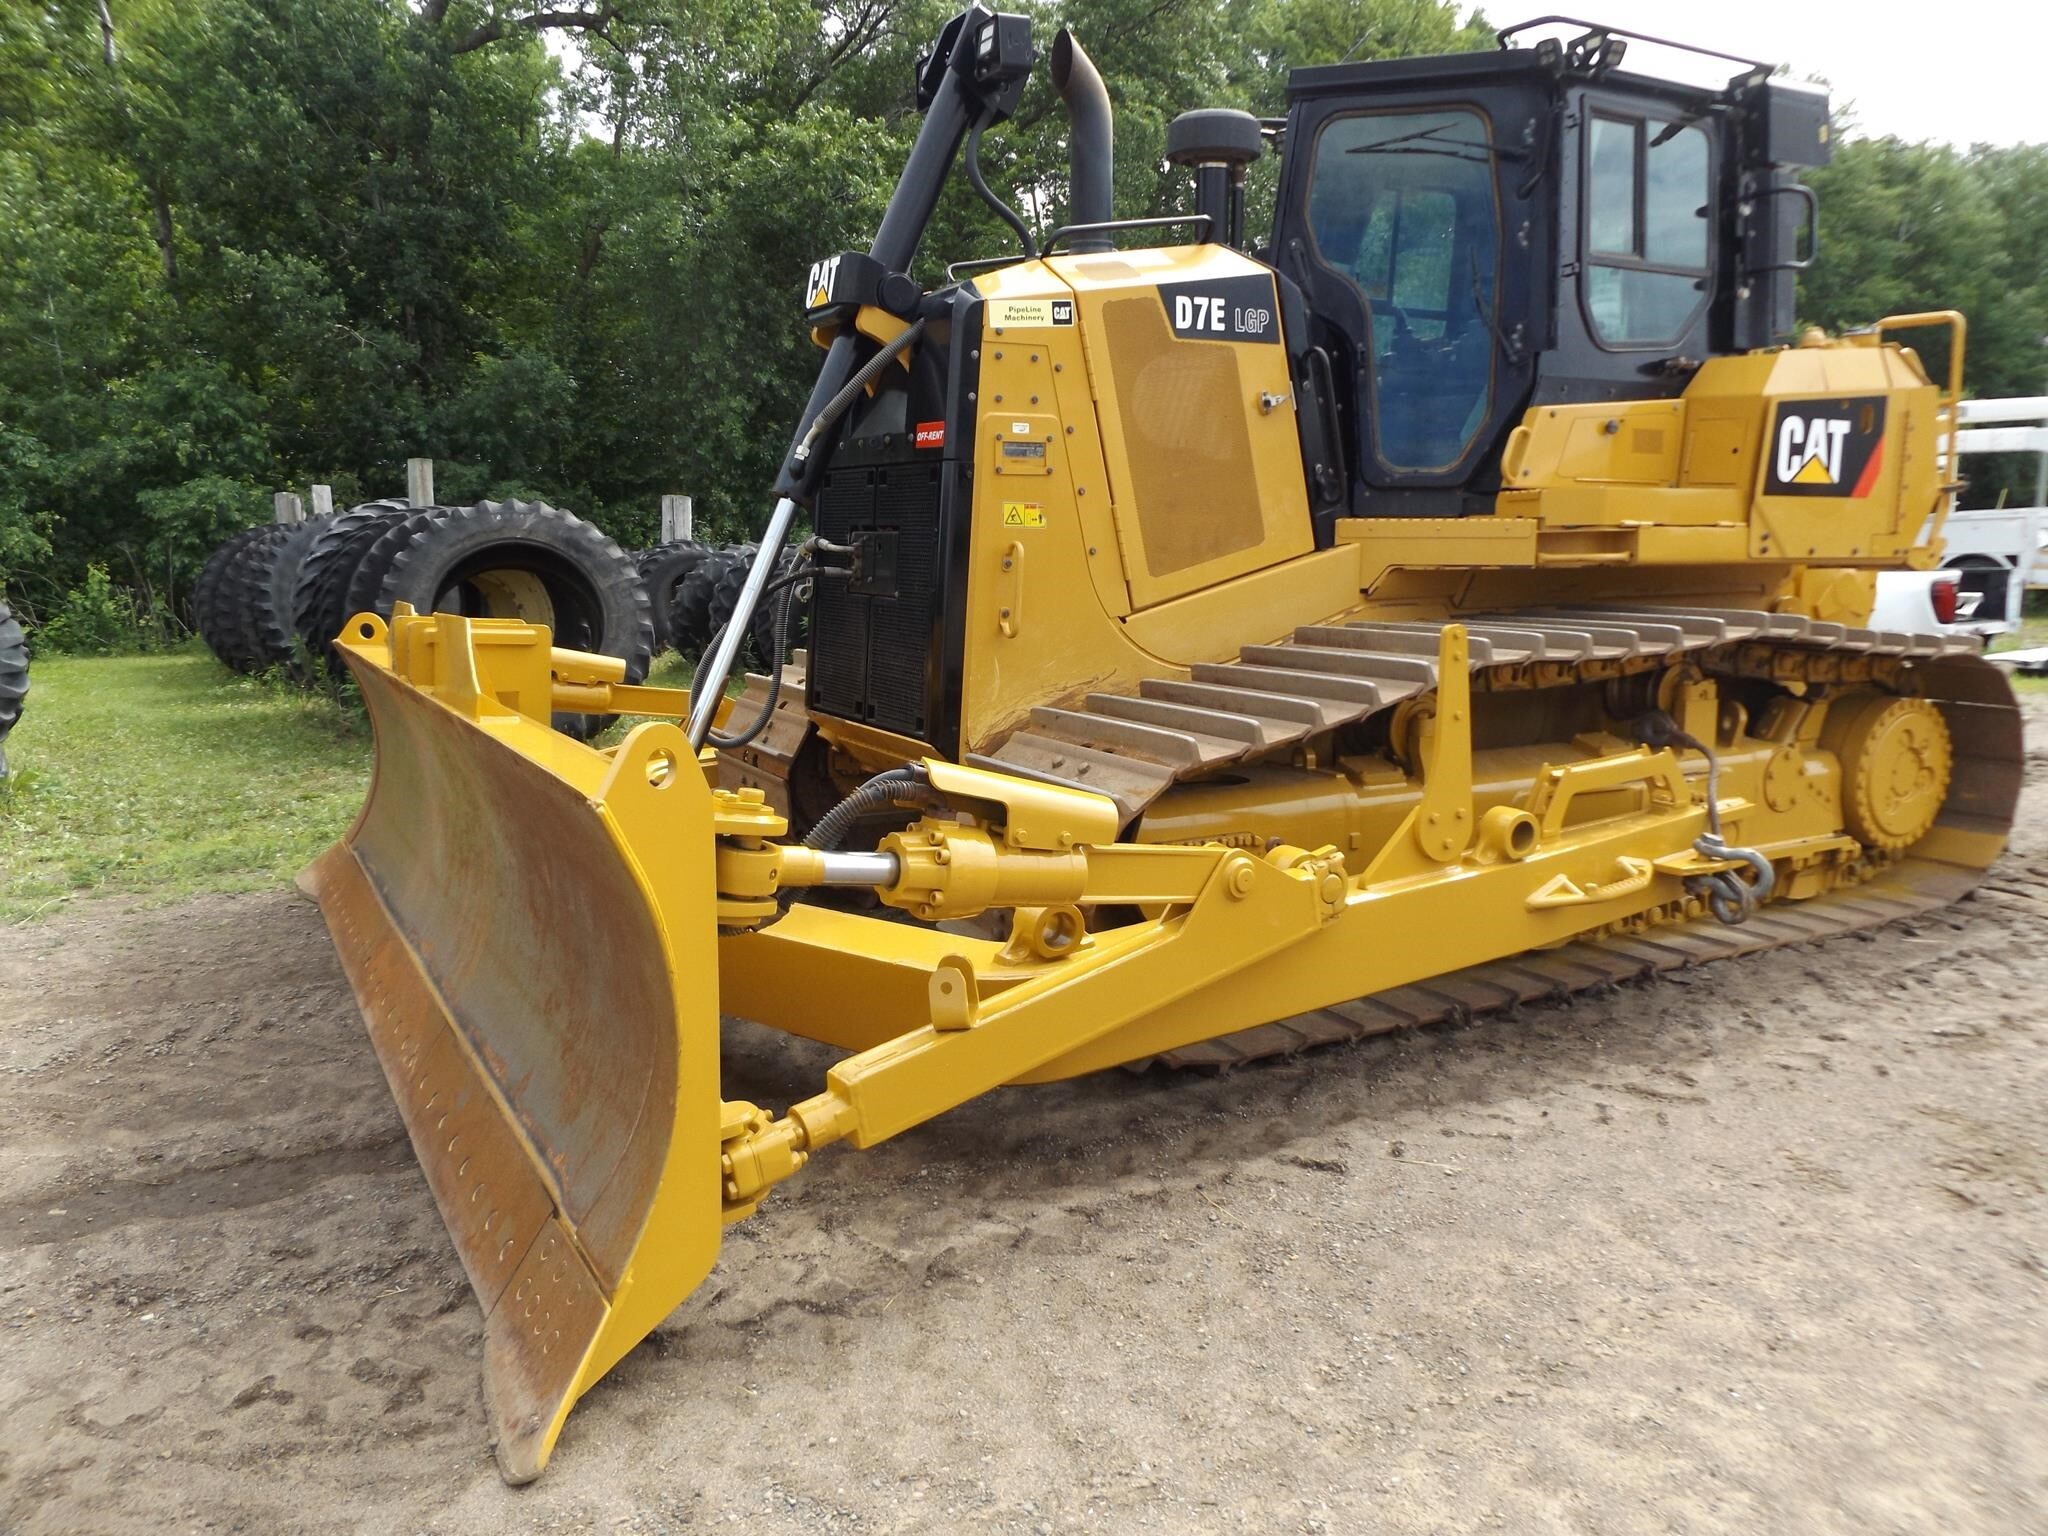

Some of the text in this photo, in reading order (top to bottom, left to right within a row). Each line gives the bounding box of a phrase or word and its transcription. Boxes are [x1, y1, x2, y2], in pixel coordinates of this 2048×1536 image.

[805, 255, 841, 309] CAT
[1053, 306, 1071, 320] CAT
[1175, 295, 1270, 333] D7E LGP
[916, 430, 944, 442] OFF-RENT
[1776, 415, 1851, 484] CAT
